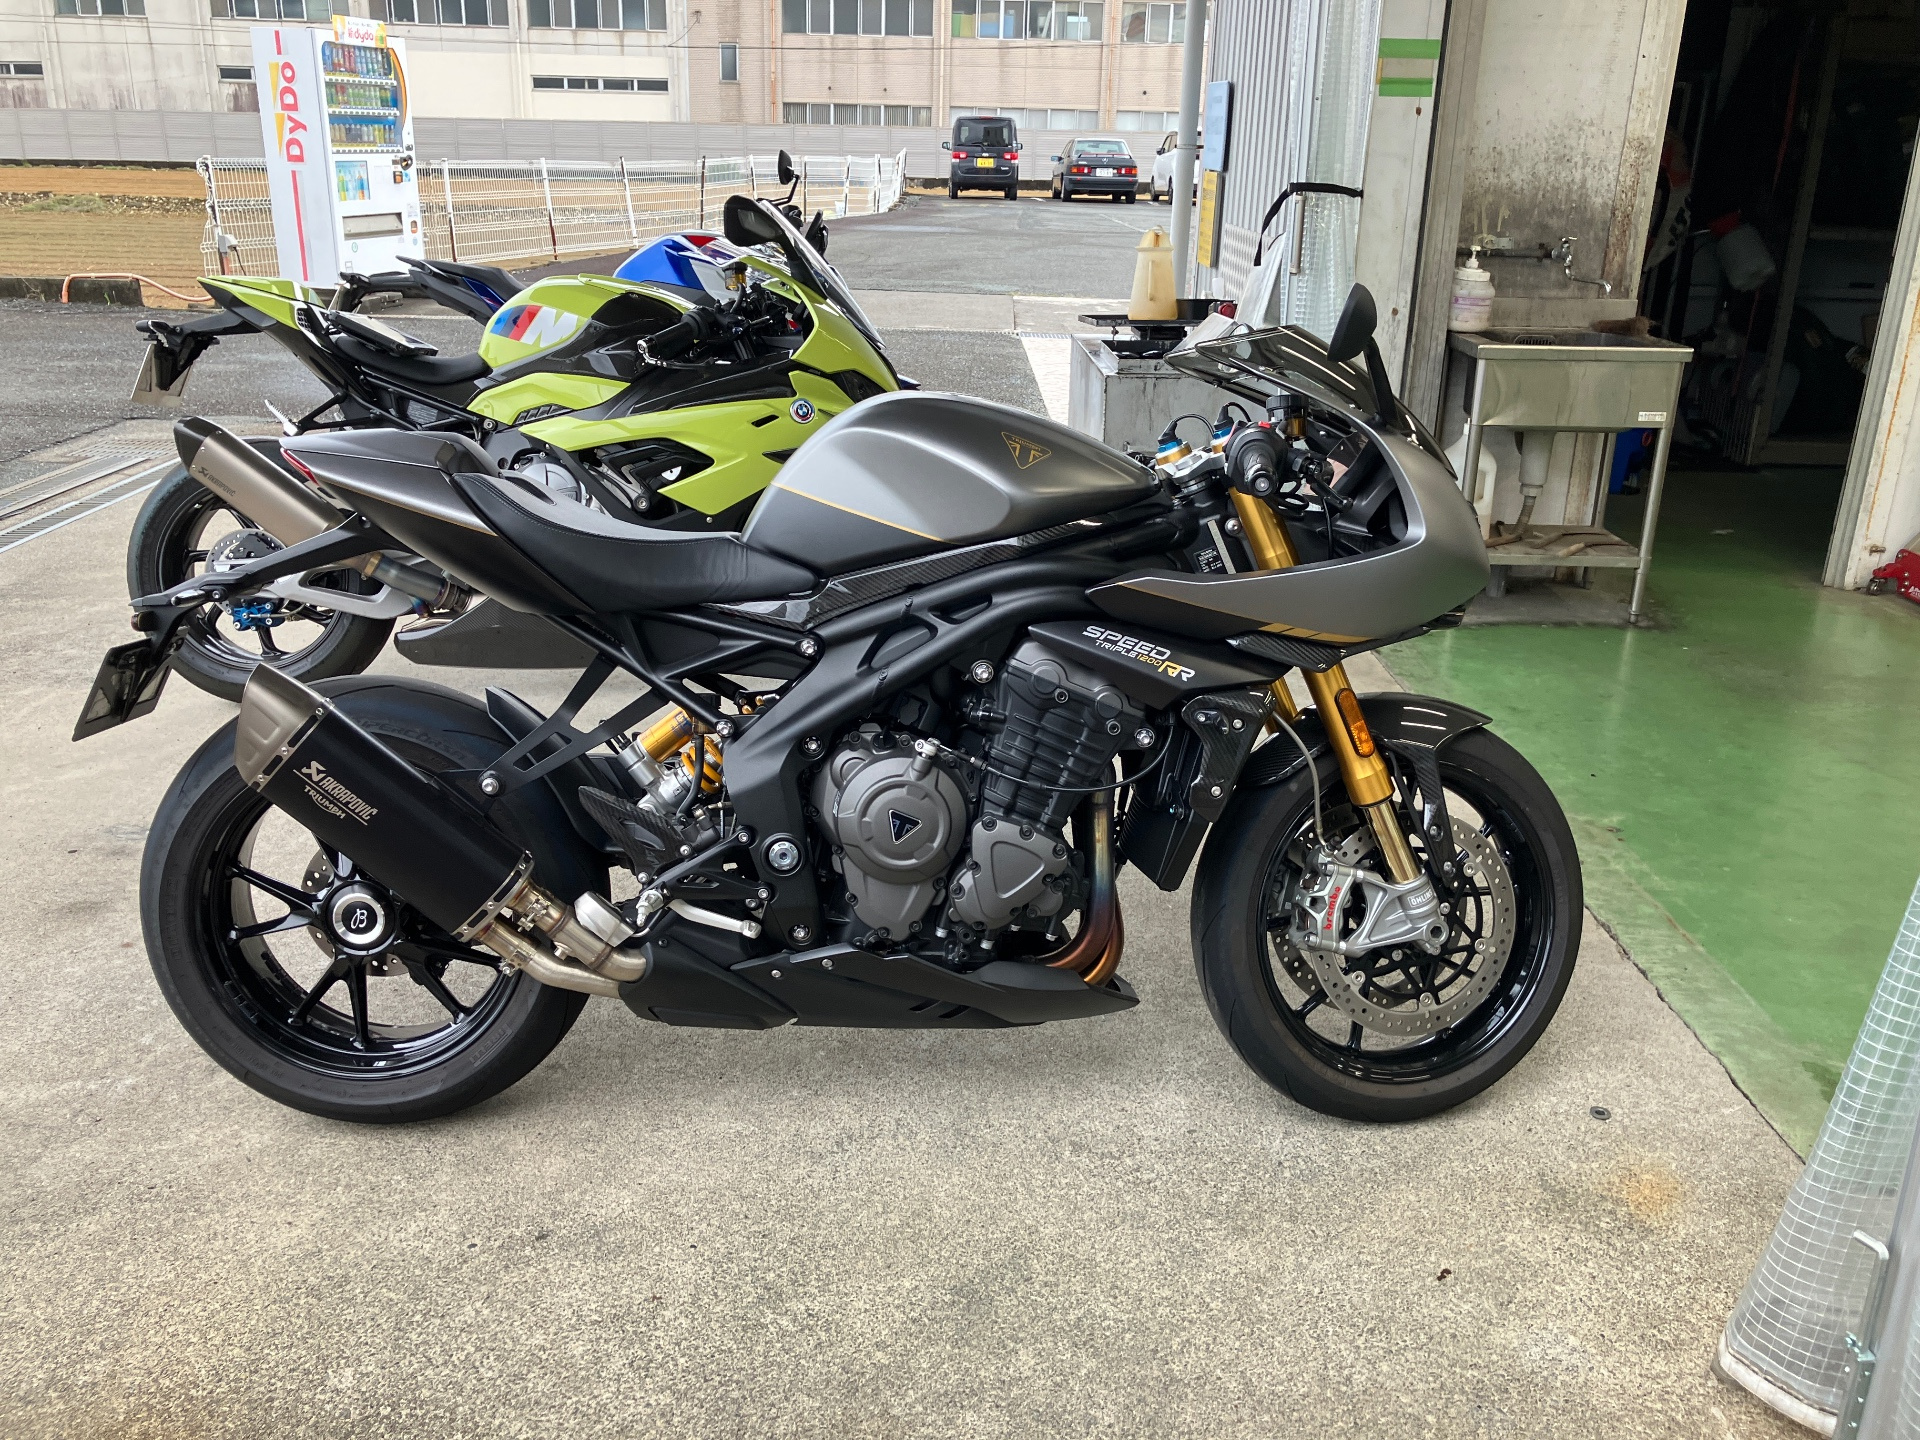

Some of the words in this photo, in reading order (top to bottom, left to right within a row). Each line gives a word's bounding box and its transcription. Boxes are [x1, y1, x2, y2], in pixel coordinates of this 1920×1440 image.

[1082, 625, 1171, 660] SPEED
[1095, 639, 1138, 659] TRIPLE
[1158, 660, 1196, 682] RR
[303, 784, 347, 819] TRIUMPH
[1322, 885, 1342, 931] brembo
